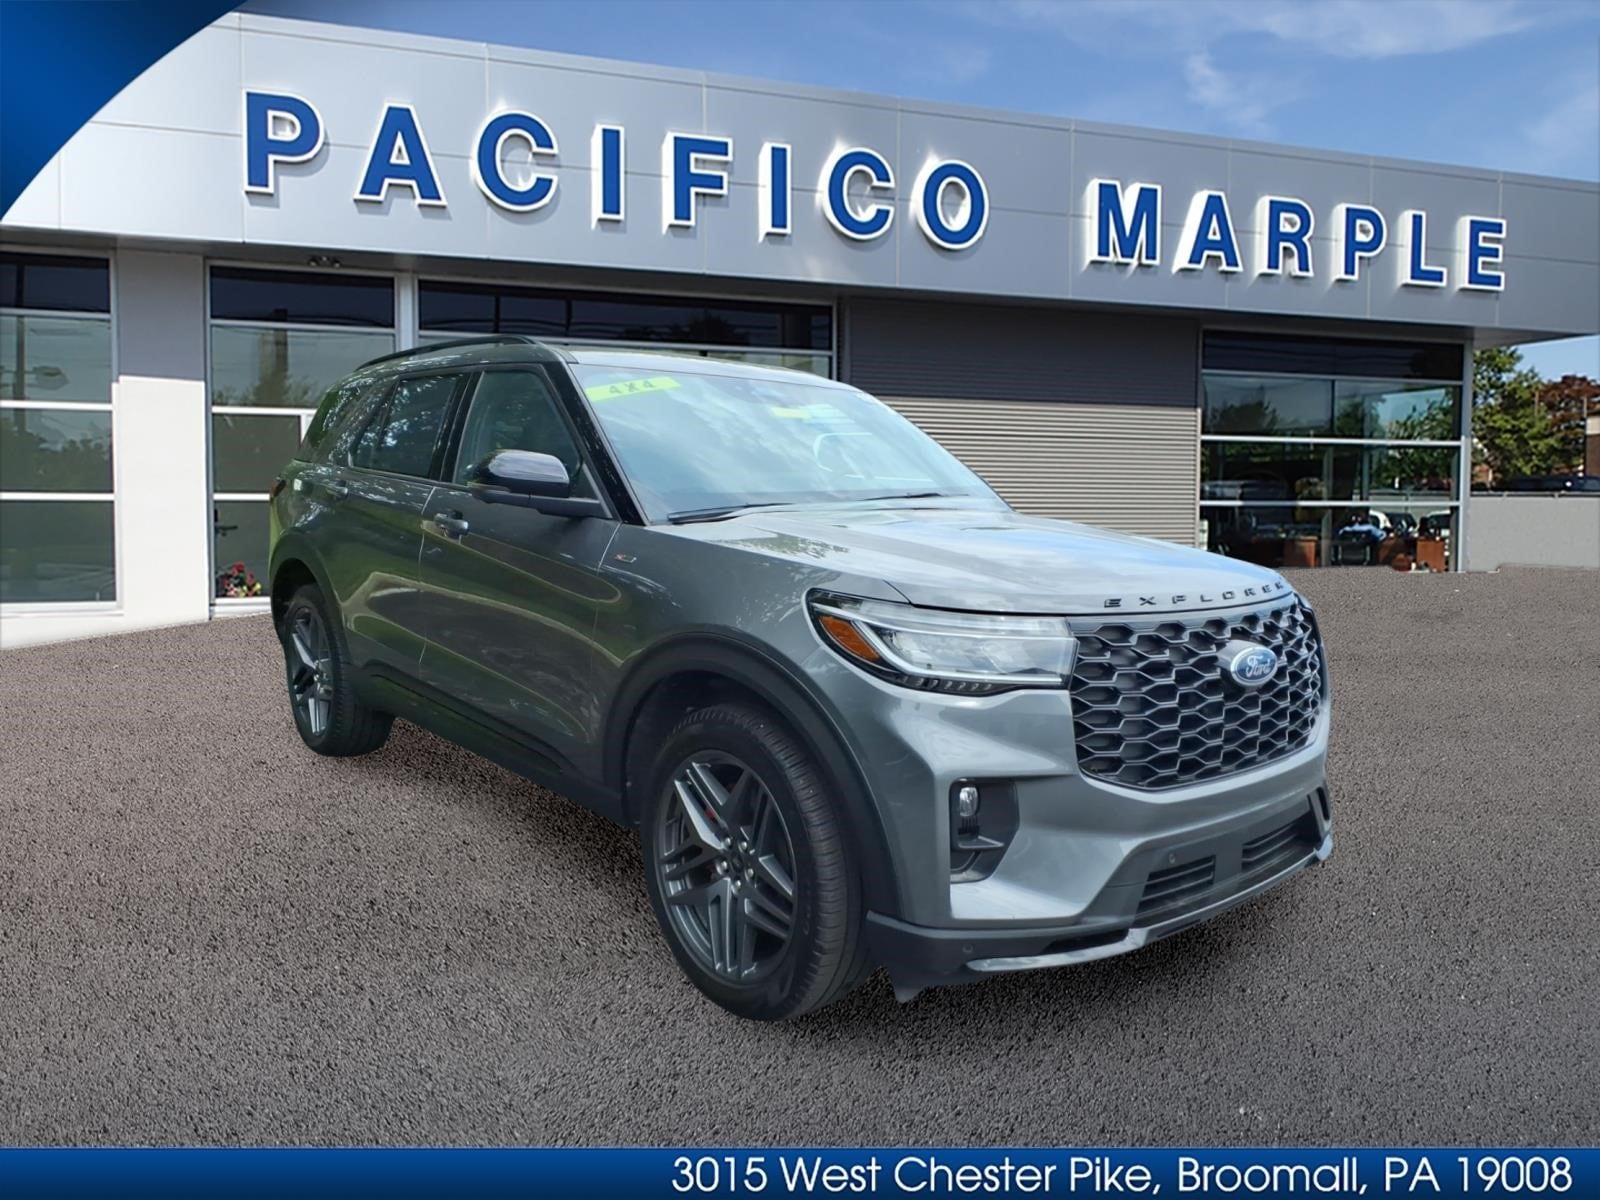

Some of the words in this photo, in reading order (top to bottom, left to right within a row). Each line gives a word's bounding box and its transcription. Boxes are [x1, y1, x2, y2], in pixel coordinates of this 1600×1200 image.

[244, 89, 989, 249] PACIFICO
[1090, 181, 1507, 291] MARPLE
[1104, 581, 1285, 608] EXPLORER
